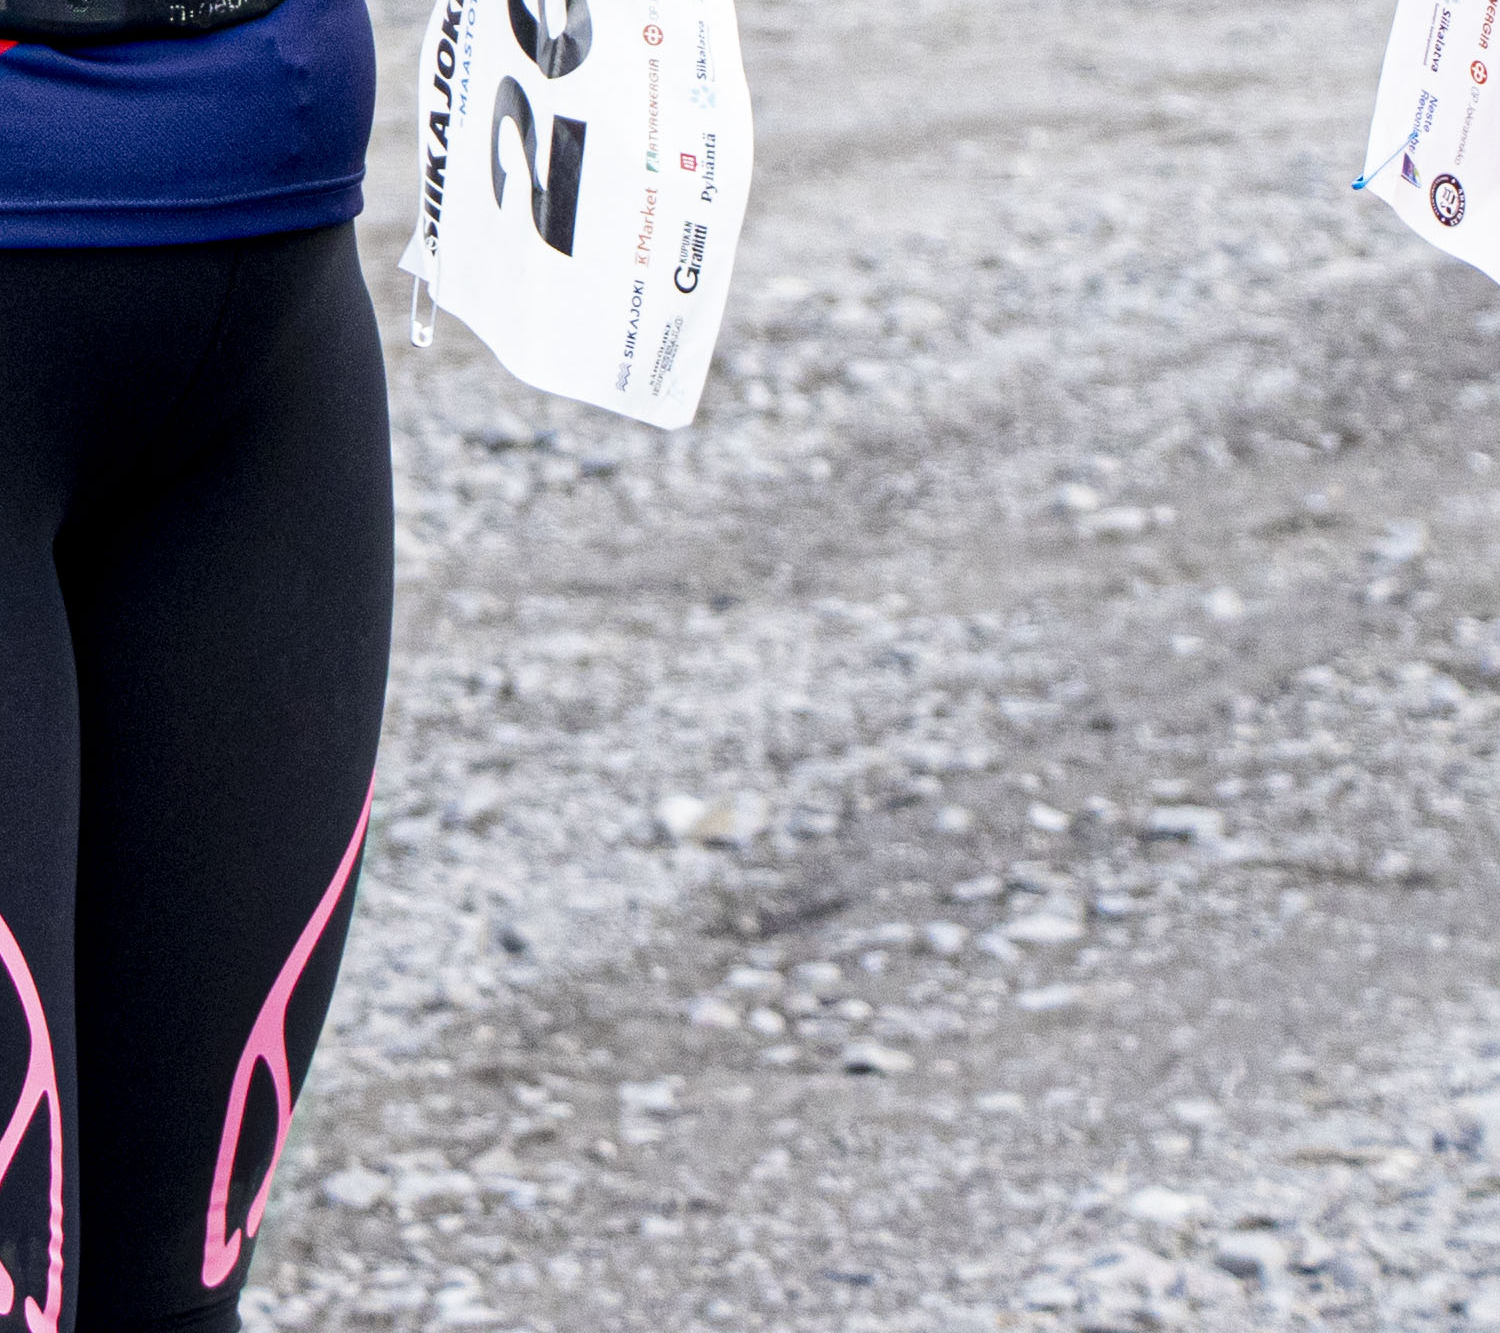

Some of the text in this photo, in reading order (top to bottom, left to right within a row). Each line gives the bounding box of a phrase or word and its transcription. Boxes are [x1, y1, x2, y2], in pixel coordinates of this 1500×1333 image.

[697, 19, 707, 81] Siikalatva
[1430, 7, 1452, 74] Siikalatva
[1423, 94, 1439, 133] Neste
[701, 132, 719, 204] Pyhäntä
[636, 187, 658, 254] Market
[679, 220, 694, 265] KUPUKAN
[624, 279, 646, 360] SIIKAJOKI
